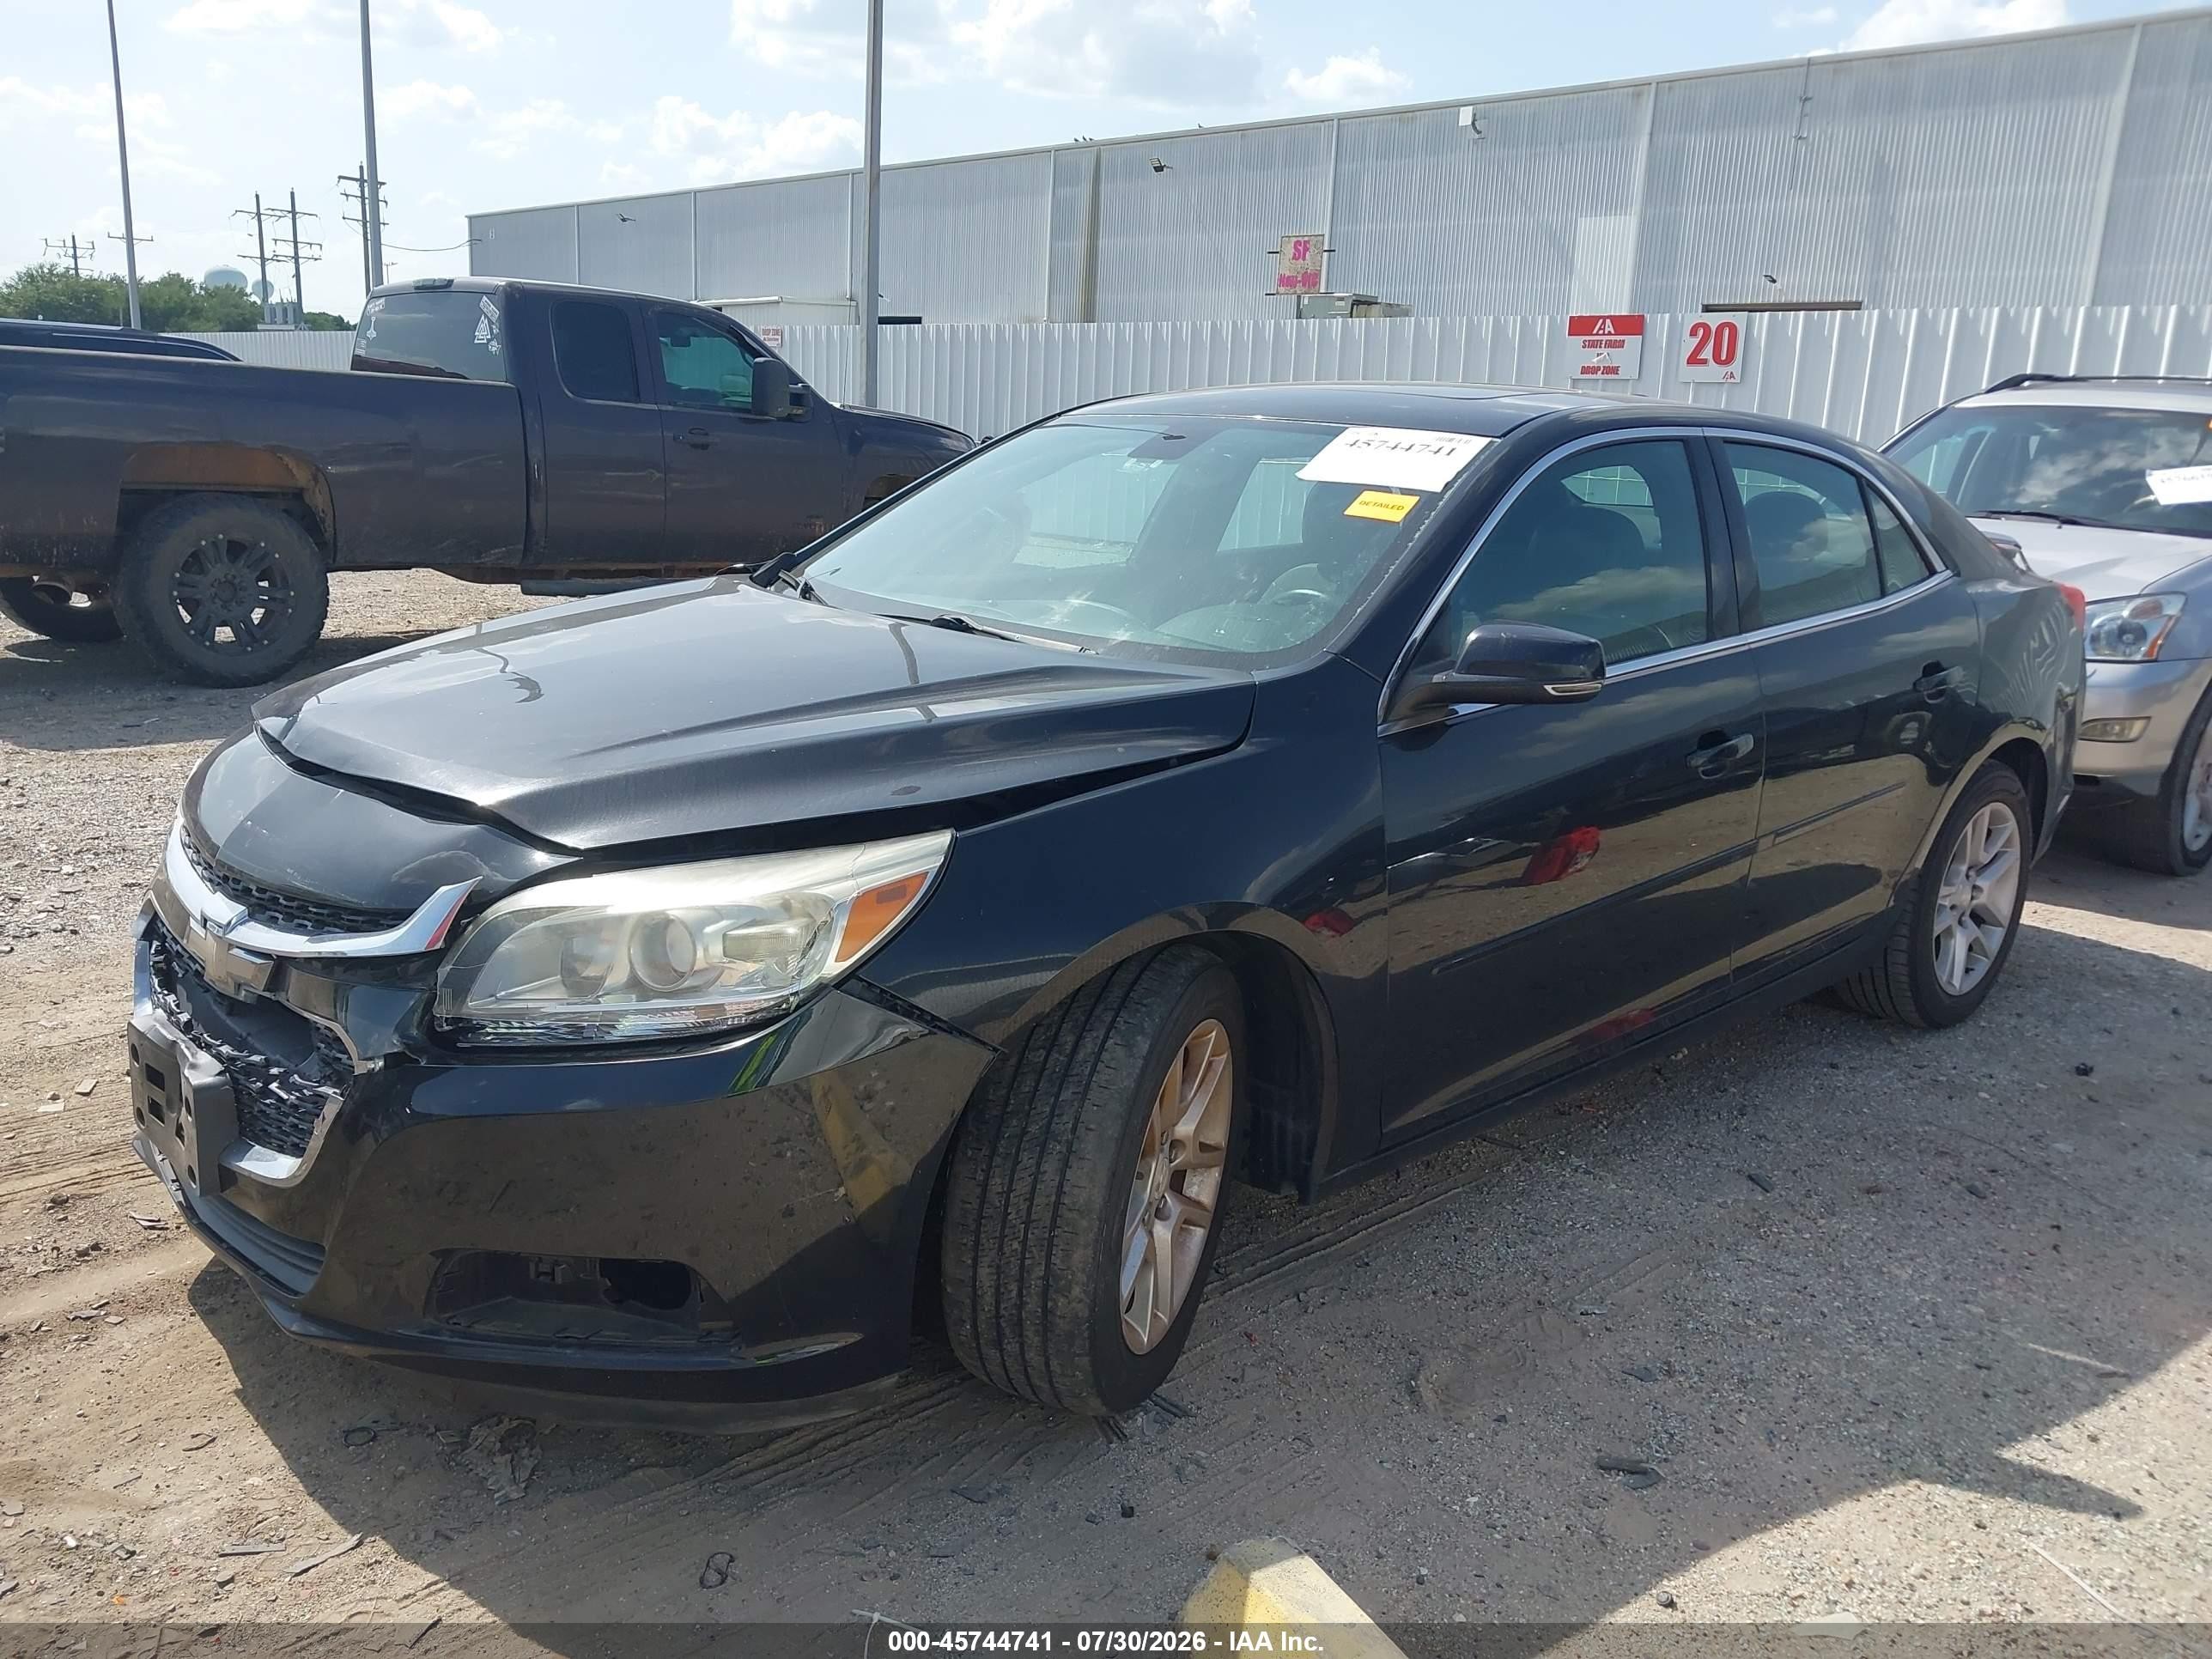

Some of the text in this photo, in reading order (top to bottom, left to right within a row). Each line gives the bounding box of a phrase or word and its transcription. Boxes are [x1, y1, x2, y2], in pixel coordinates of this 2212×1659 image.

[1581, 338, 1626, 349] STATE FARM
[1686, 321, 1739, 368] 20
[1580, 365, 1621, 375] DROP ZONE
[1358, 499, 1405, 511] DETAILED
